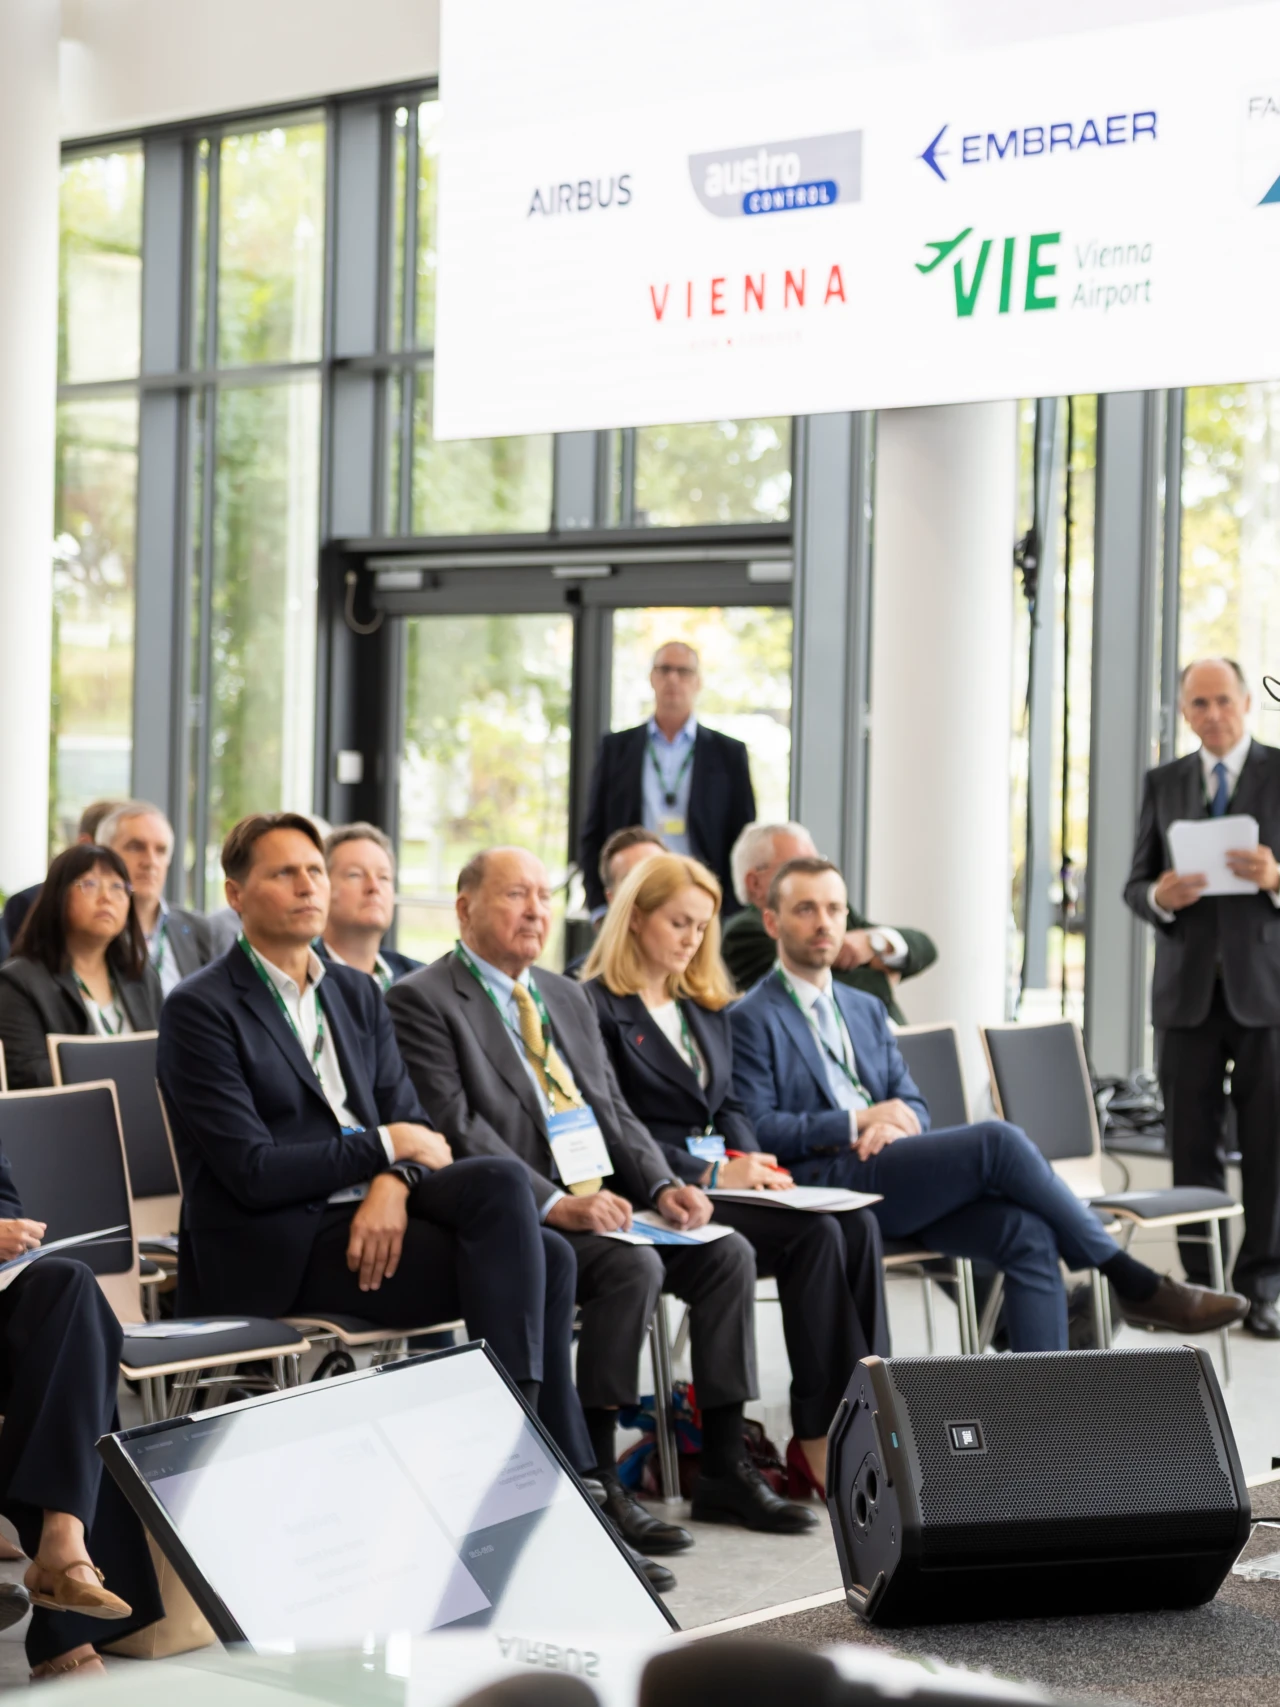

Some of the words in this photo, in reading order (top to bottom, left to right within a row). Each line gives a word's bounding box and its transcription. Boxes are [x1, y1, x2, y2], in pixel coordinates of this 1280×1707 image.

[962, 110, 1158, 165] EMBRAER
[528, 174, 633, 218] AIRBUS
[704, 147, 801, 198] austro
[749, 184, 831, 213] CONTROL
[952, 231, 1062, 318] VIE
[1075, 239, 1153, 271] Vienna
[649, 264, 847, 321] VIENNA
[1071, 277, 1152, 313] Airport
